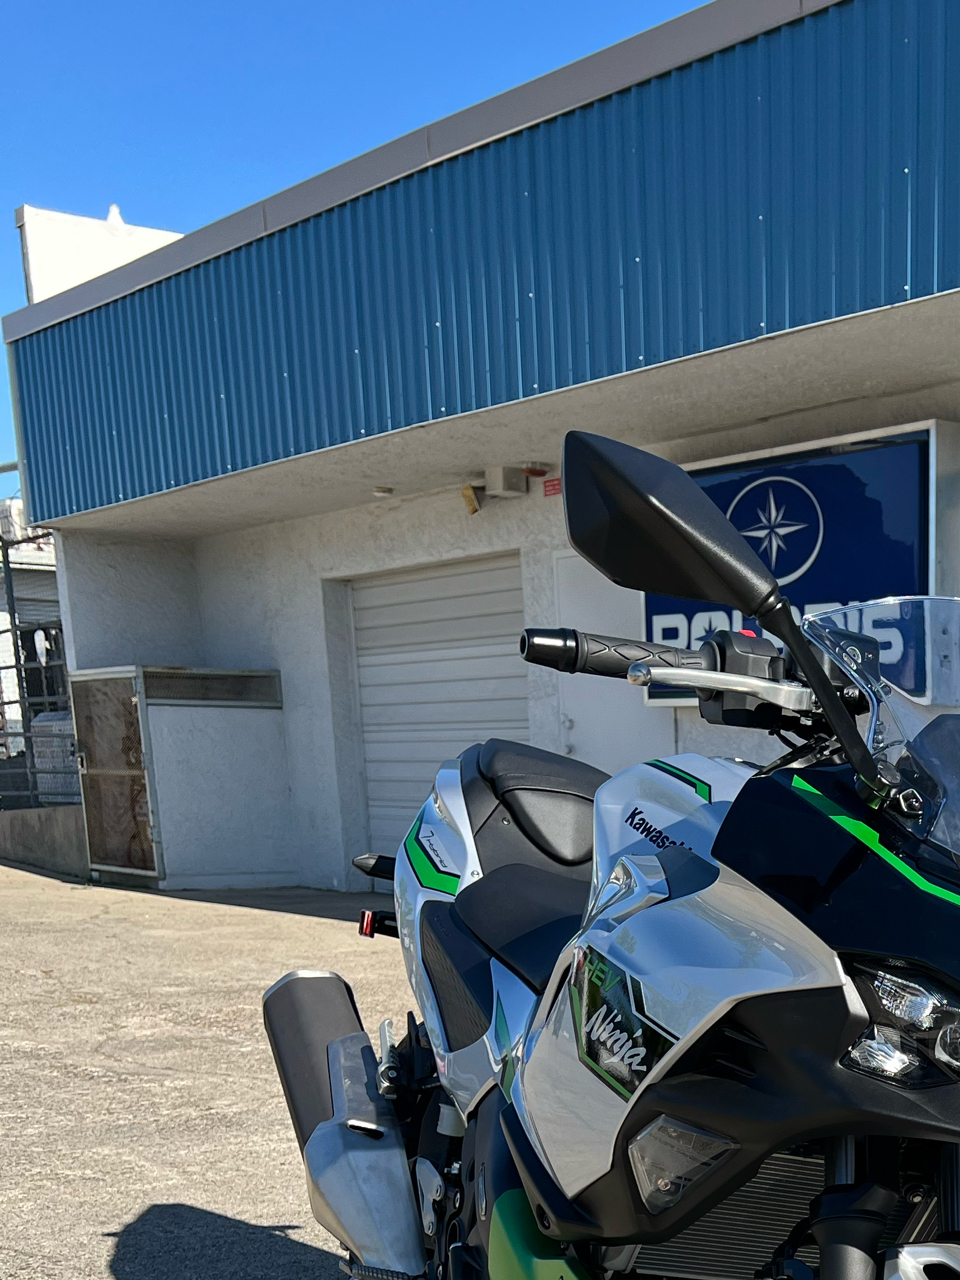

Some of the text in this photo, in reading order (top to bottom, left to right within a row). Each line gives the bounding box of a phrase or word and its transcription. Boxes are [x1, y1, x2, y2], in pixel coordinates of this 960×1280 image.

[625, 807, 692, 850] Kawas
[583, 954, 621, 992] HEV
[585, 1004, 647, 1072] Ninja
